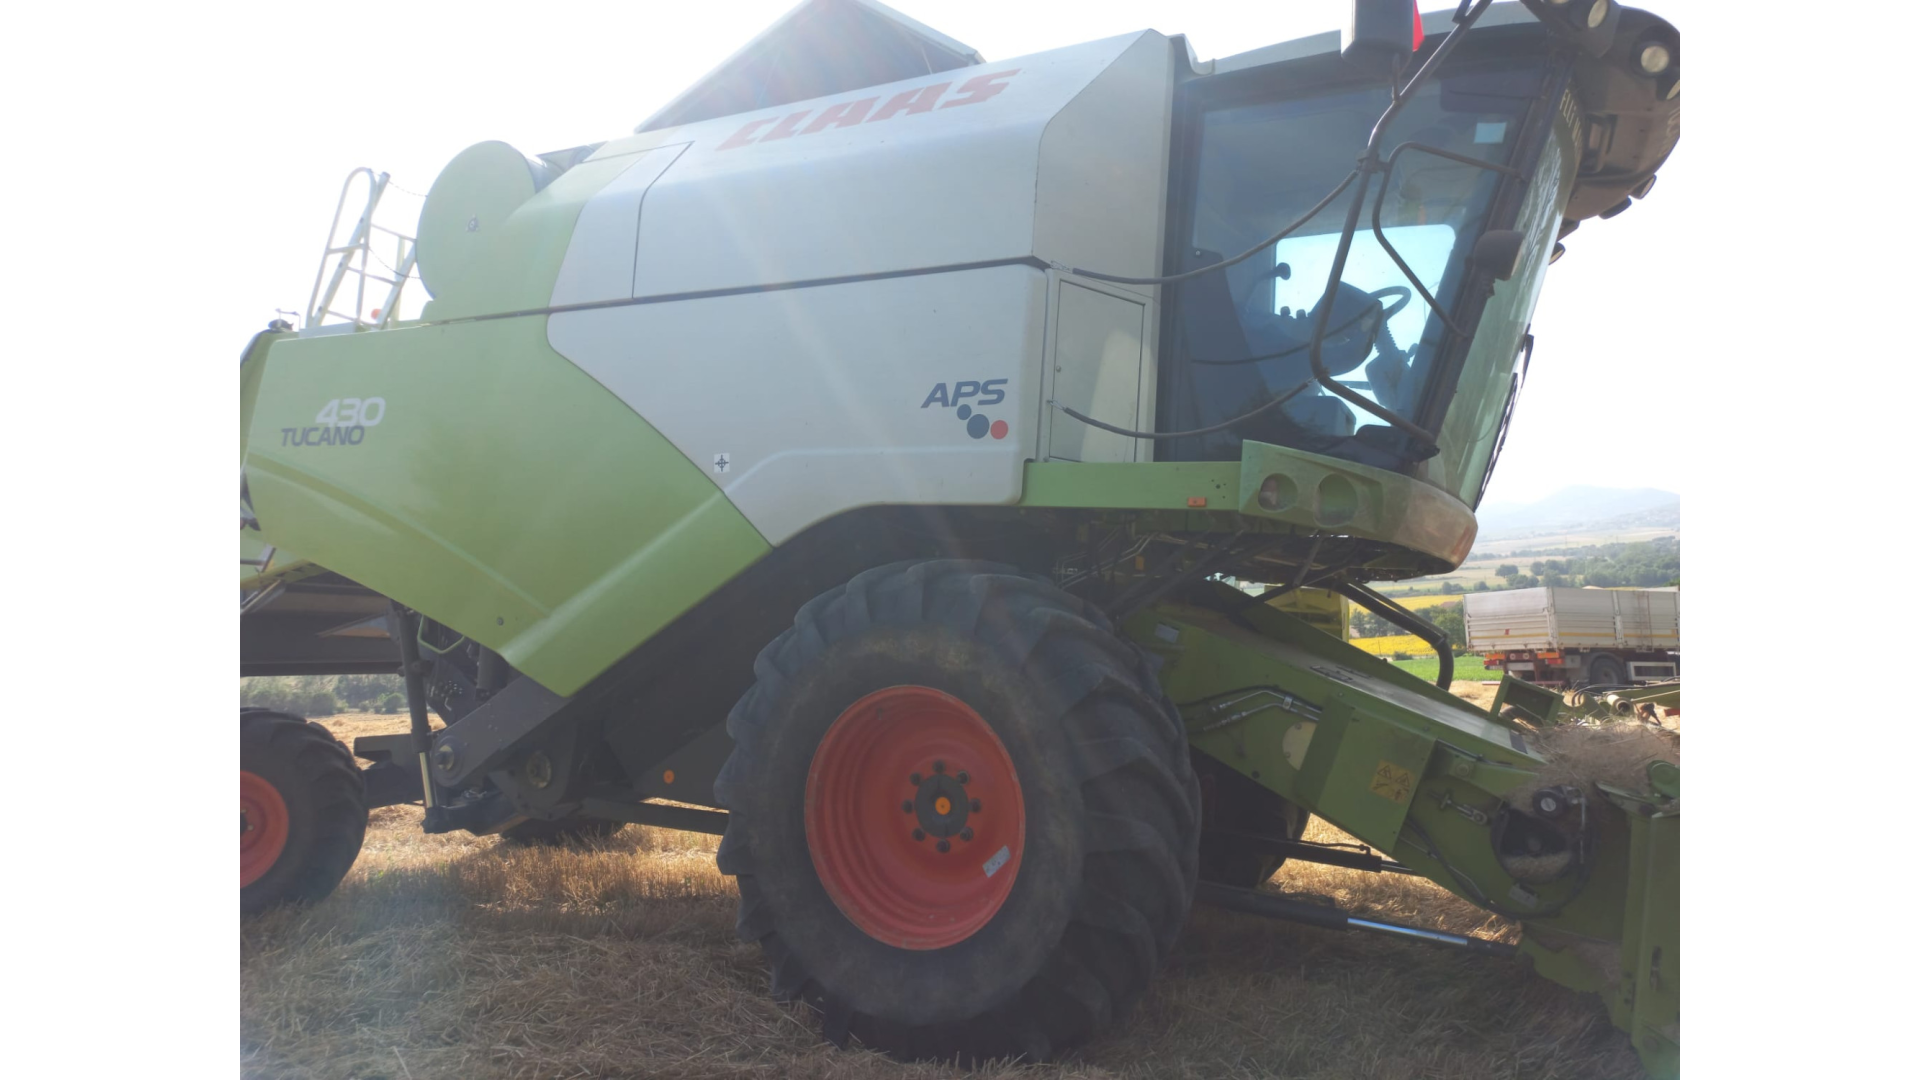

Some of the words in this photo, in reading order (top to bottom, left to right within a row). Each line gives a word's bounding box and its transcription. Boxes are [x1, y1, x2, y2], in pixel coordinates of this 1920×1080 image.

[715, 69, 1021, 151] CLAAS
[921, 378, 1008, 408] APS
[315, 396, 386, 428] 430
[281, 425, 365, 447] TUCANO
